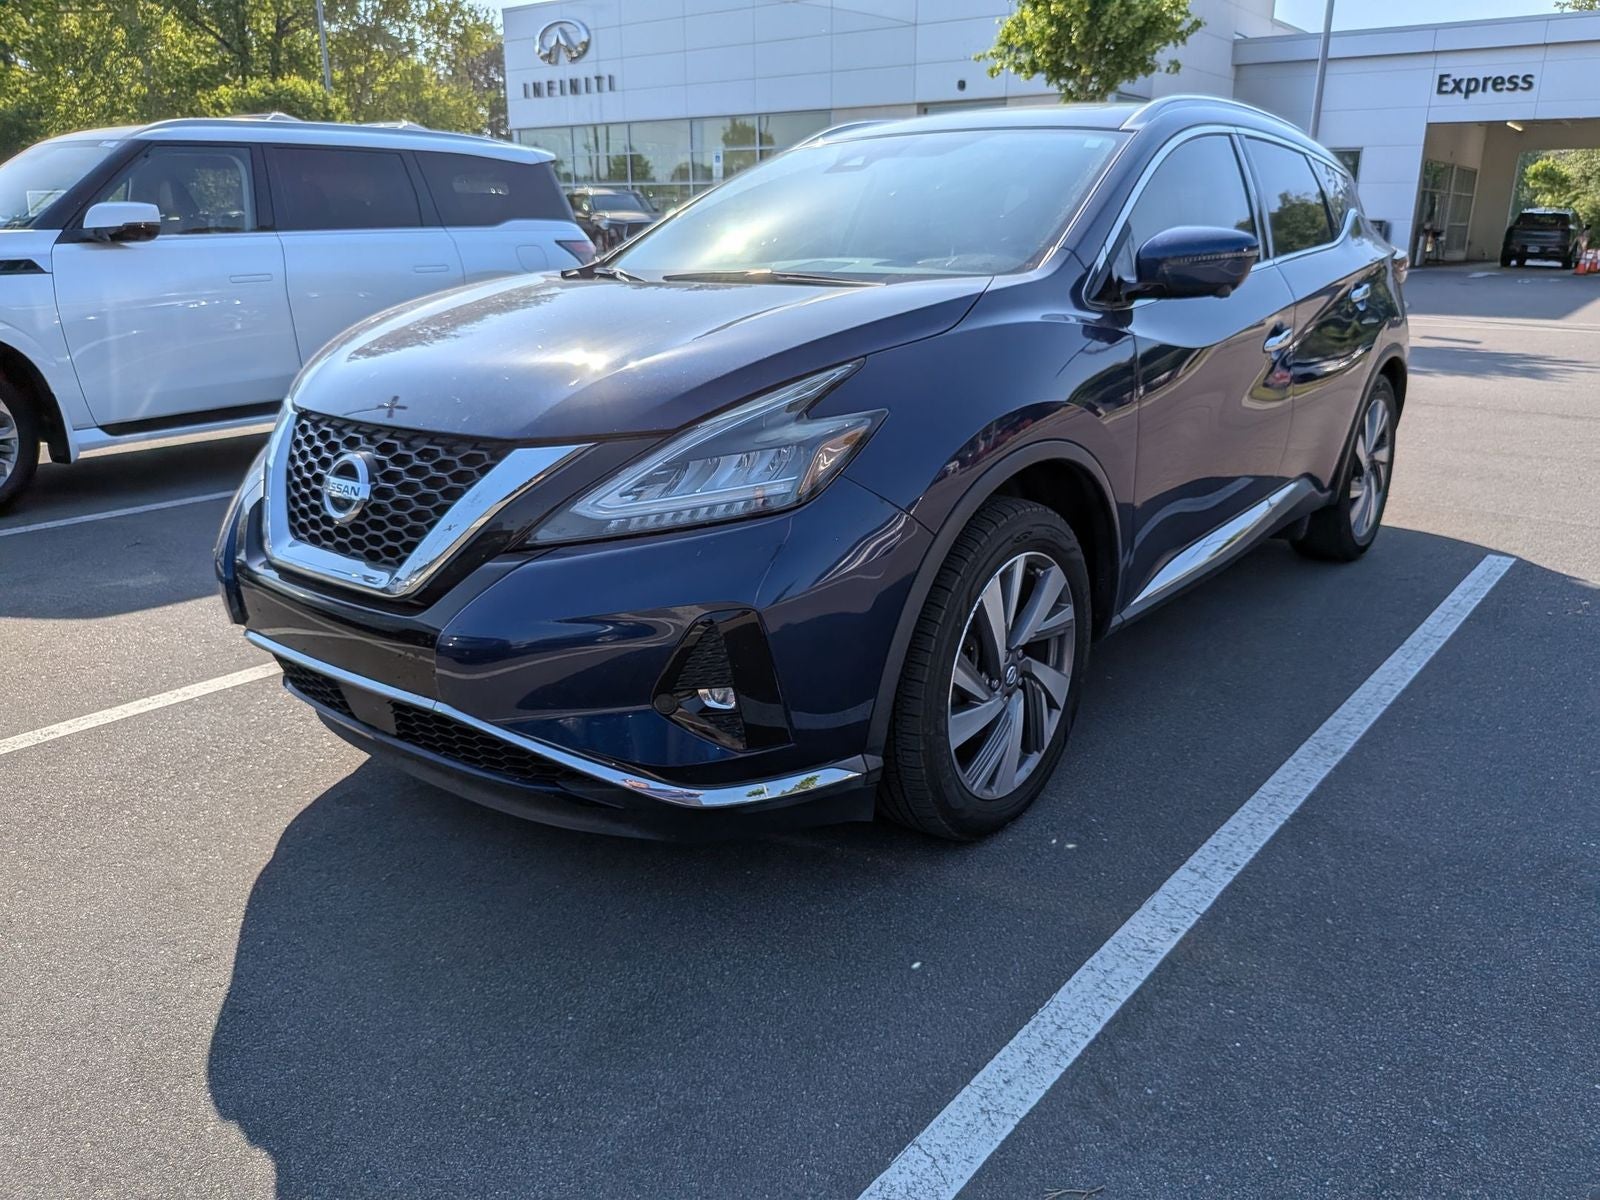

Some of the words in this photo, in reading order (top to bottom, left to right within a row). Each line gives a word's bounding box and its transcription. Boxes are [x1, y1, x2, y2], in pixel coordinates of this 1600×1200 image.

[523, 74, 615, 99] INFINITI
[1436, 73, 1535, 99] Express
[326, 481, 361, 497] SSAN
